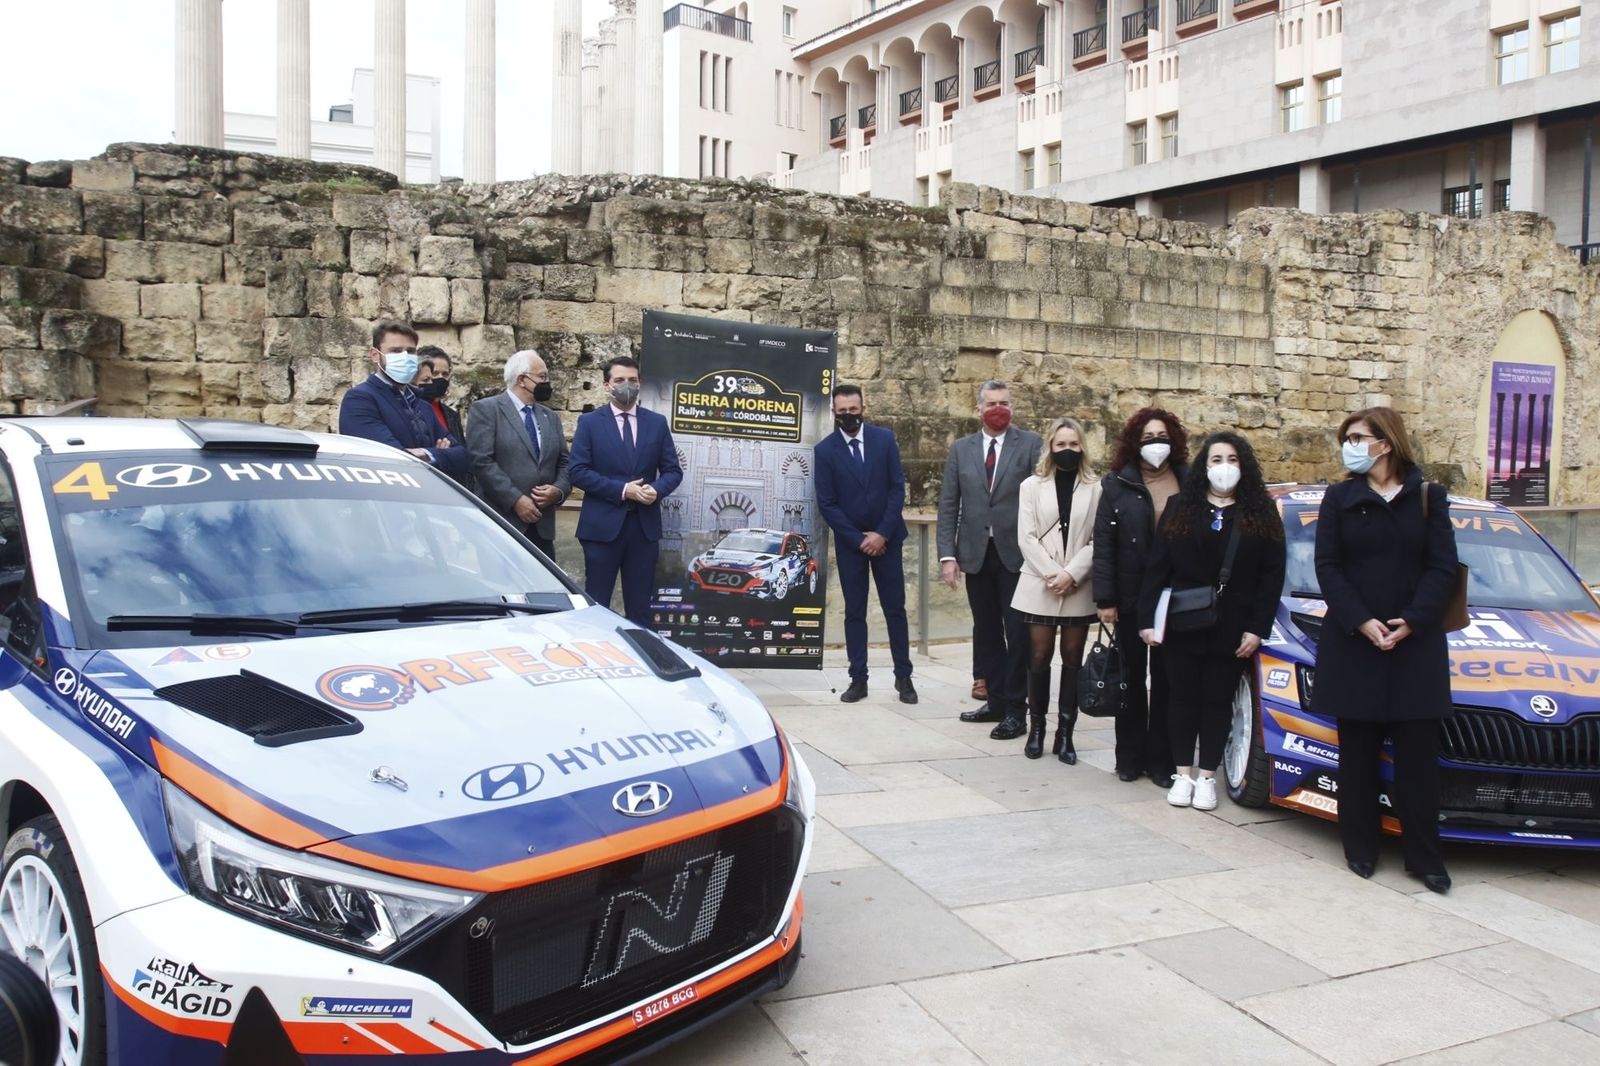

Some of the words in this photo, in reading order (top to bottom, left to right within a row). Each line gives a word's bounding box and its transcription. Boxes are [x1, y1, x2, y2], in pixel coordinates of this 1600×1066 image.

[713, 375, 737, 394] 39
[678, 392, 730, 408] SIERRA
[733, 397, 796, 414] MORENA
[677, 405, 706, 418] Rallye
[733, 411, 771, 423] CÓRDOBA
[52, 462, 118, 500] 4
[220, 463, 421, 488] HYUNDAI
[708, 571, 741, 587] i20
[1448, 638, 1554, 652] network
[1270, 670, 1290, 681] UFI
[1449, 658, 1600, 684] ecalv
[1267, 679, 1287, 687] FILTERS
[73, 682, 136, 740] HYUNDAI
[547, 728, 717, 775] HYUNDAI
[1306, 744, 1339, 760] MICHE
[1274, 761, 1302, 775] RACC
[151, 980, 232, 1017] PAGID
[635, 1010, 643, 1022] S
[645, 998, 669, 1017] 9278
[671, 987, 694, 1004] BCG
[331, 1004, 411, 1013] MICHELIN
